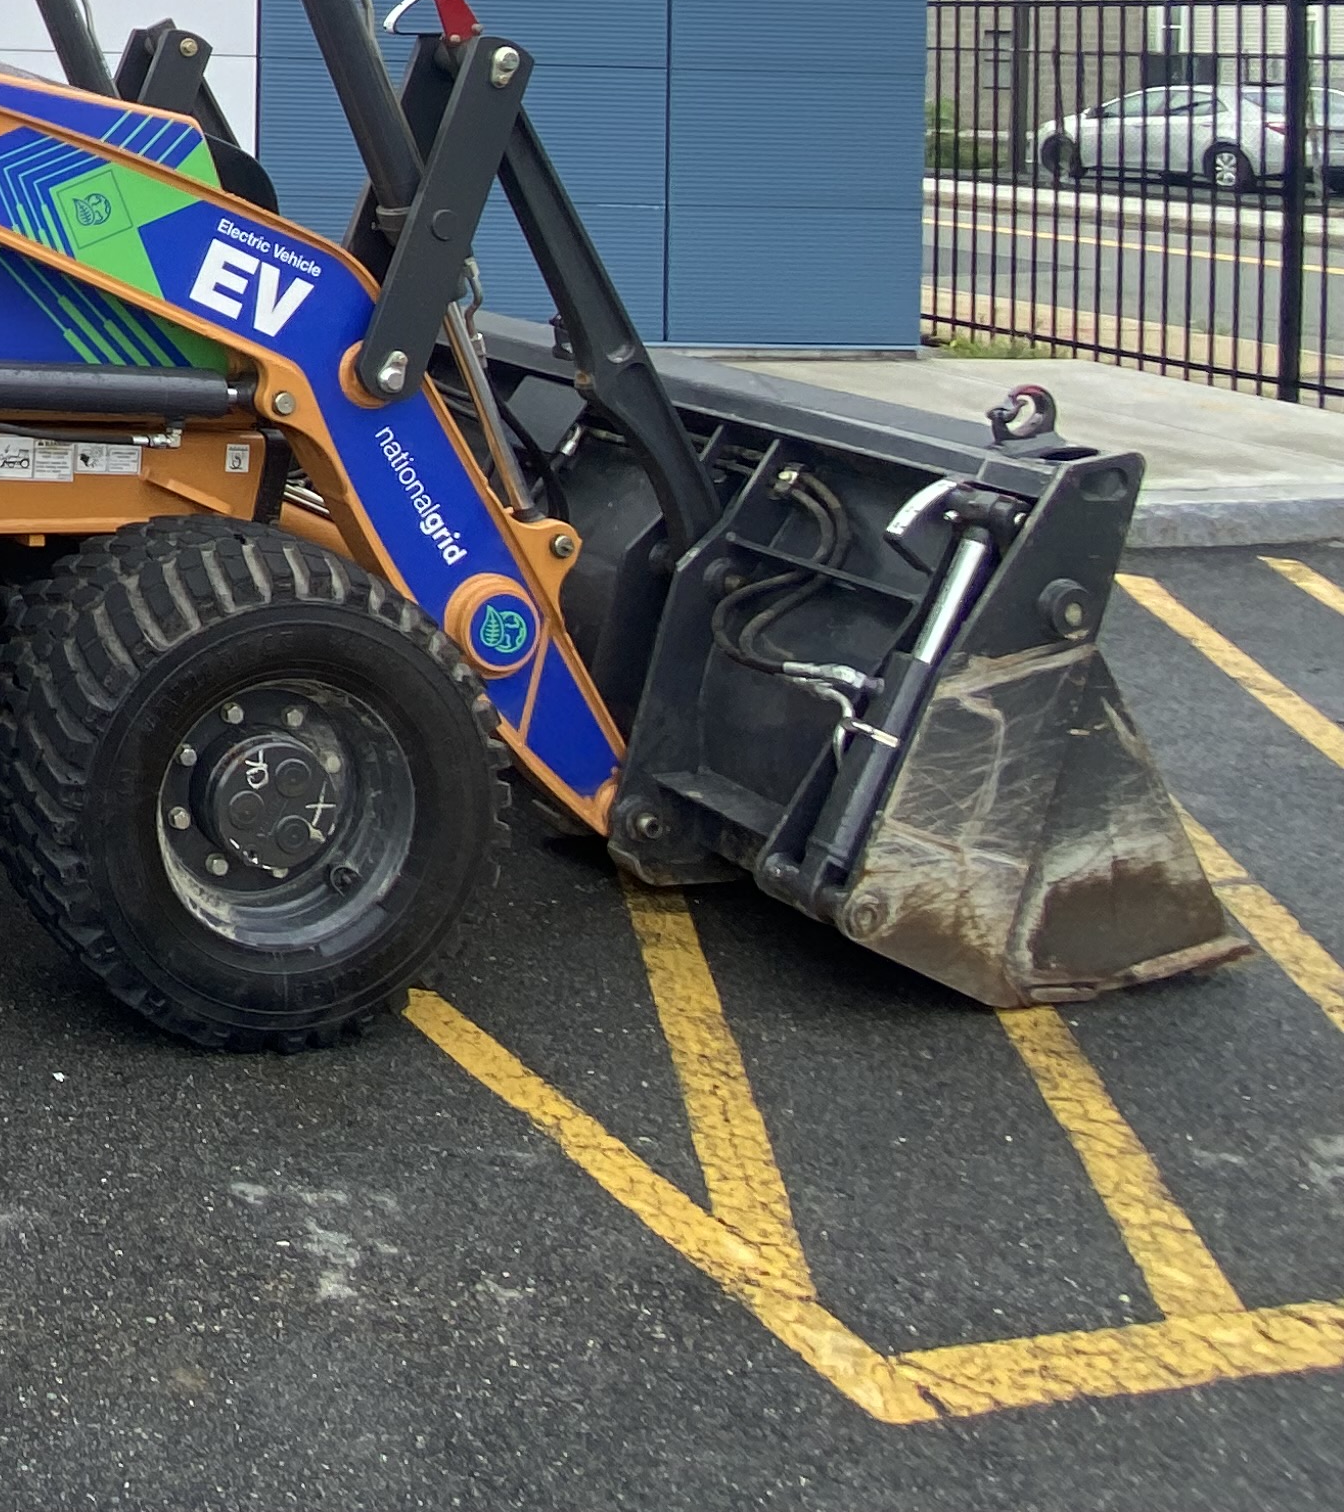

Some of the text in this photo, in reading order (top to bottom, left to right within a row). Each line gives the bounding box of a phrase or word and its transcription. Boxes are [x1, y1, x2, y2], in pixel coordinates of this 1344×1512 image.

[190, 238, 315, 337] EV
[217, 218, 322, 277] Electric Vehicle
[375, 426, 468, 566] nationalgrid
